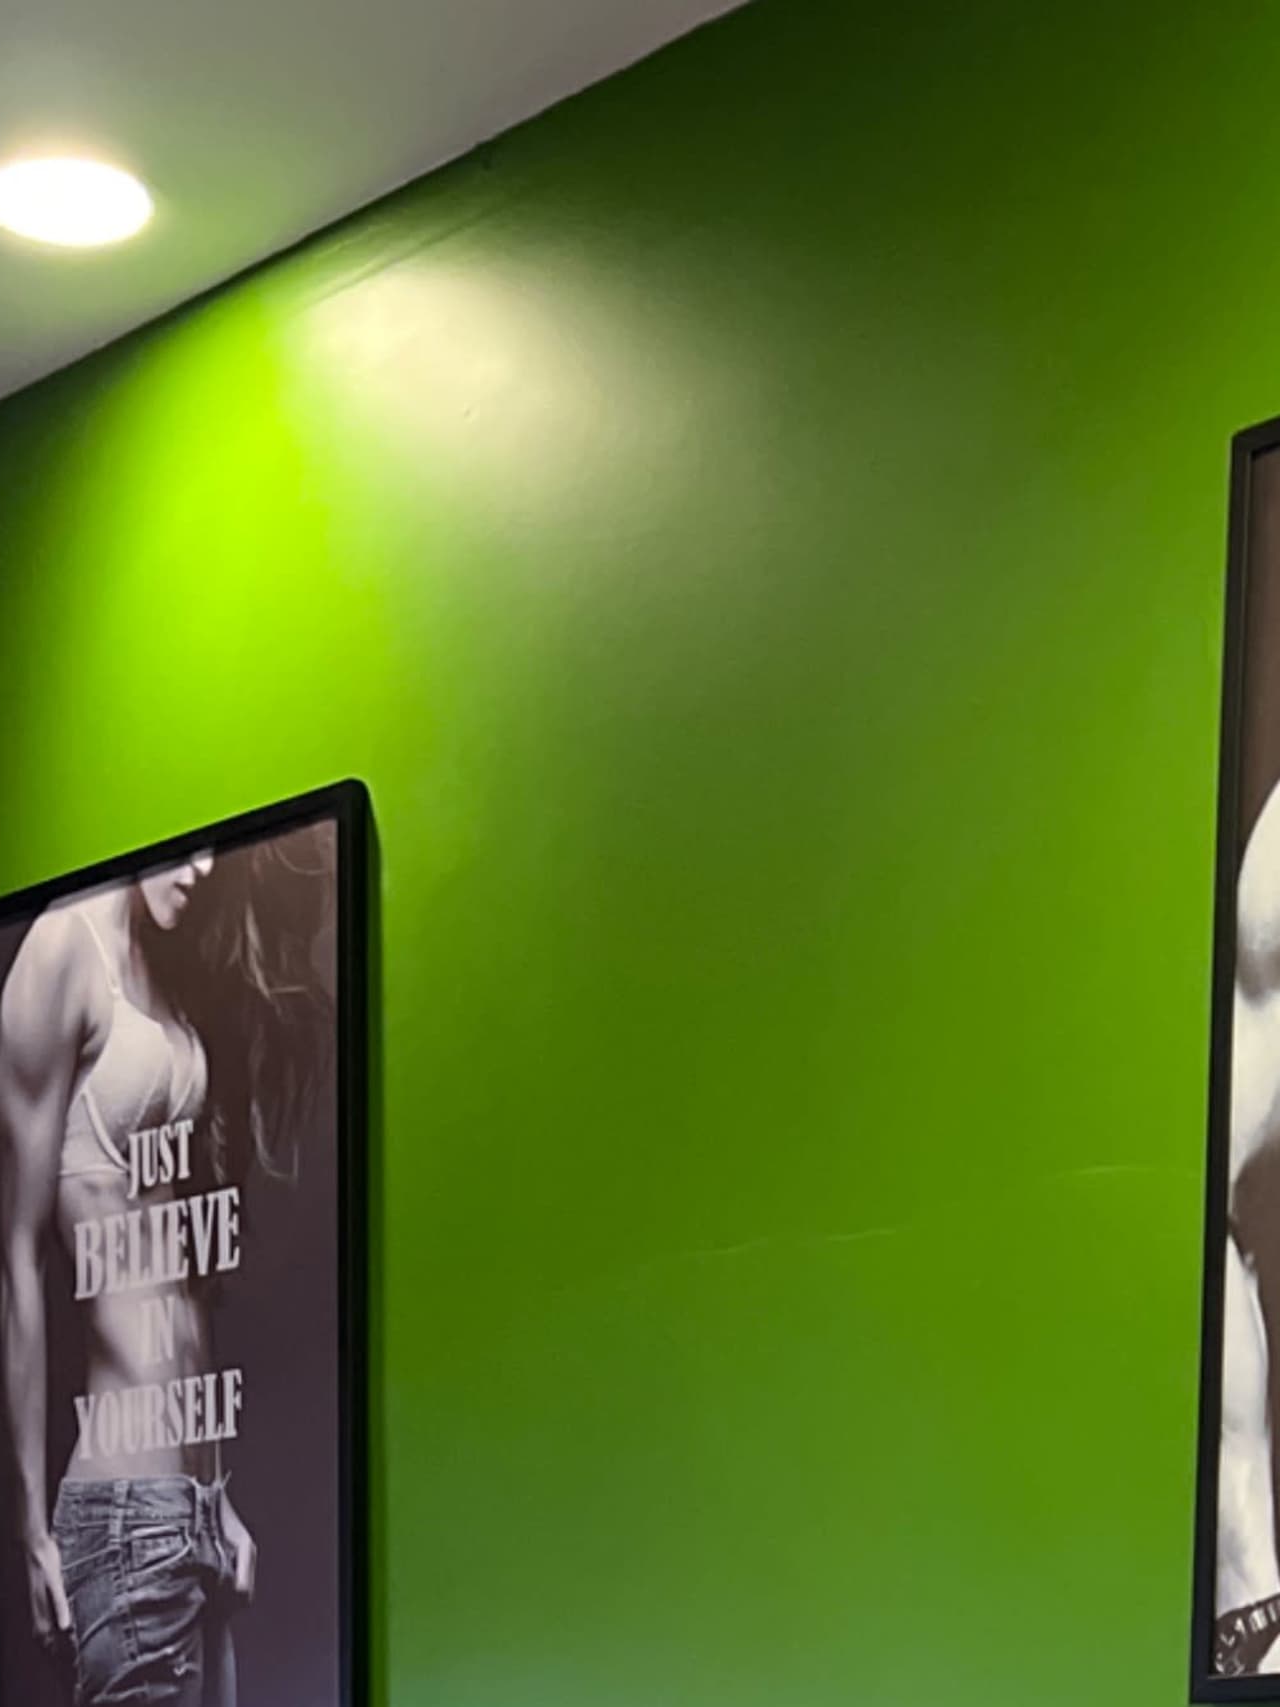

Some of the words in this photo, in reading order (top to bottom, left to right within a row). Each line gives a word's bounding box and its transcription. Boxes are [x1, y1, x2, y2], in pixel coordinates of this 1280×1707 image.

[127, 1119, 194, 1199] JUST
[74, 1187, 240, 1300] BELIEVE
[139, 1295, 175, 1364] IN
[74, 1368, 243, 1461] YOURSELF
